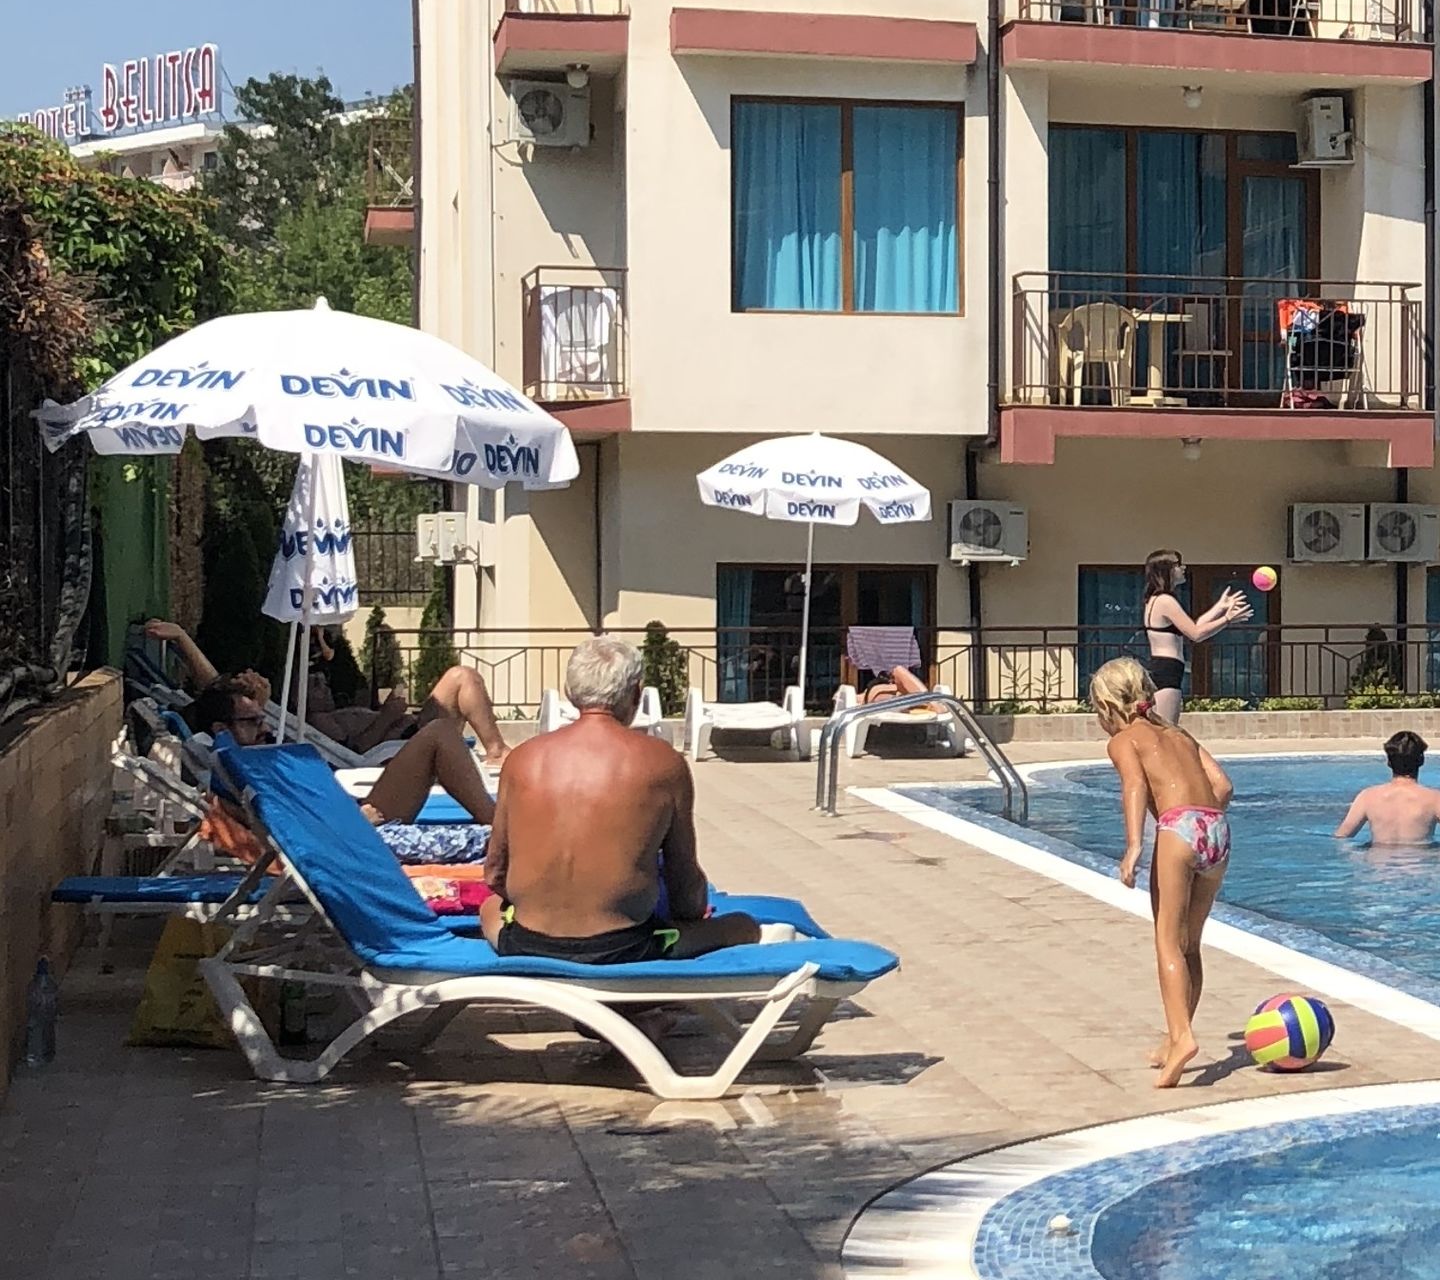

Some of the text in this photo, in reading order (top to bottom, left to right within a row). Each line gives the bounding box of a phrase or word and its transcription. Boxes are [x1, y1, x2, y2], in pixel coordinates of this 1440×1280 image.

[100, 43, 216, 131] BELITSA
[132, 367, 246, 390] DEVIN
[280, 373, 413, 400] DEVIN
[440, 382, 530, 413] DEVIN
[304, 422, 405, 458] DEVIN
[484, 442, 539, 475] DEVIN
[719, 463, 768, 479] DEVIN
[782, 471, 842, 488] DEVIN
[858, 473, 908, 490] DEVIN
[714, 489, 752, 507] DEVIN
[788, 501, 835, 519] DEVIN
[878, 502, 915, 520] DEVIN
